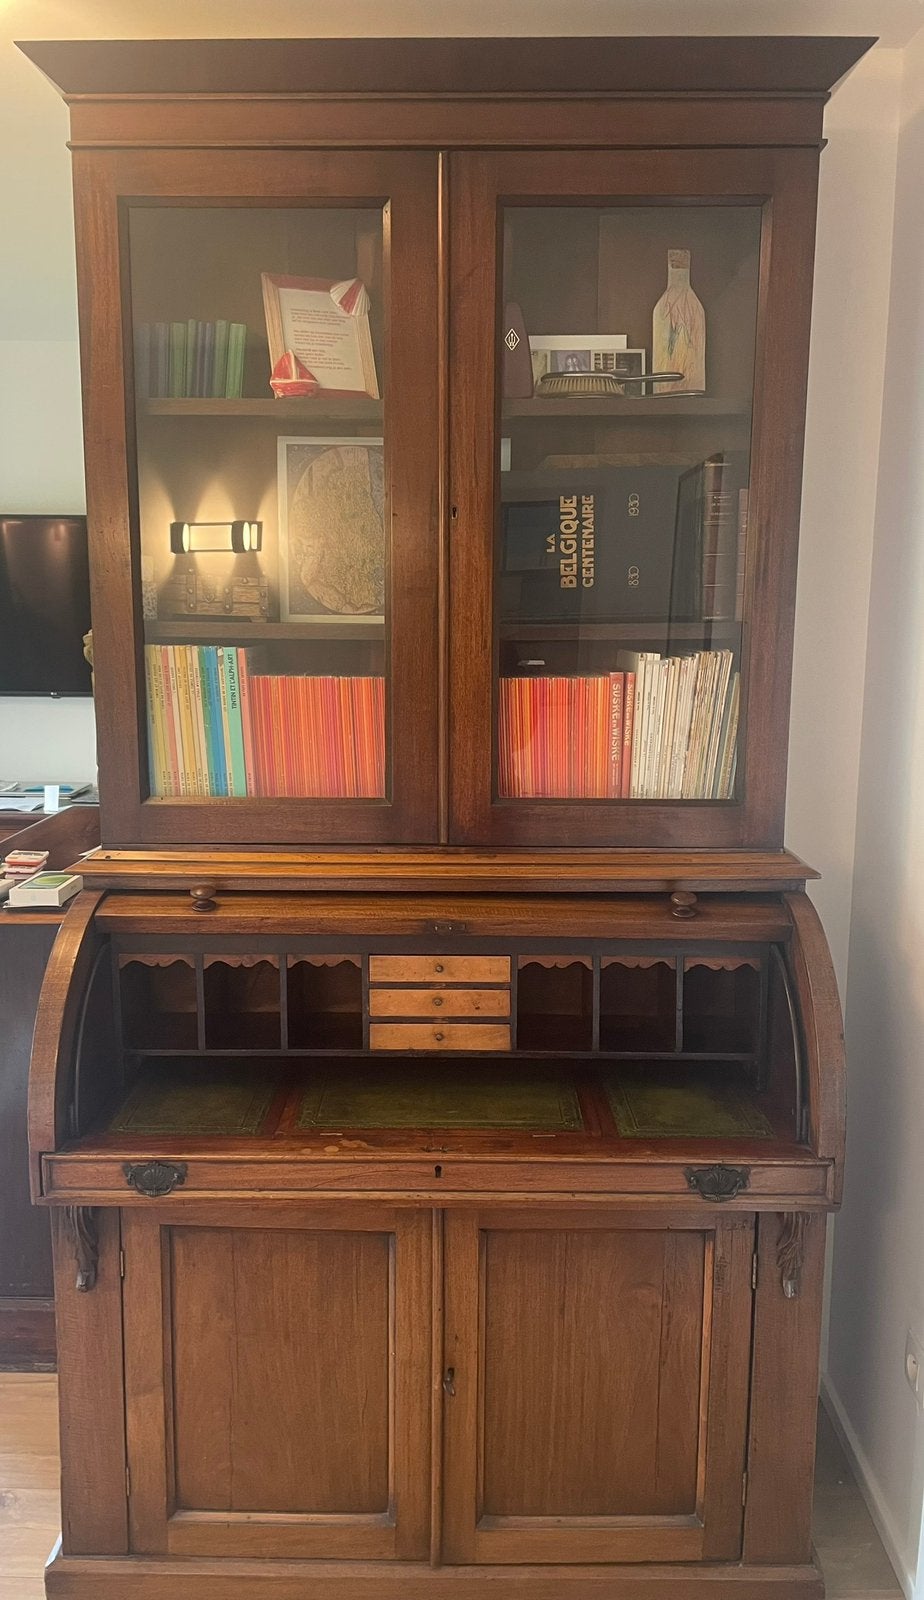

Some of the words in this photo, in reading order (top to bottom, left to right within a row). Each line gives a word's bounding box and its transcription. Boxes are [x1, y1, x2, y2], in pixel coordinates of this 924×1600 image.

[546, 534, 556, 553] LA
[560, 495, 580, 589] BELGIQUE
[581, 495, 595, 588] CENTENAIRE
[612, 683, 621, 720] SUSKE
[625, 683, 633, 713] SUSKE
[611, 728, 620, 761] WISKE
[624, 720, 632, 746] WISKE
